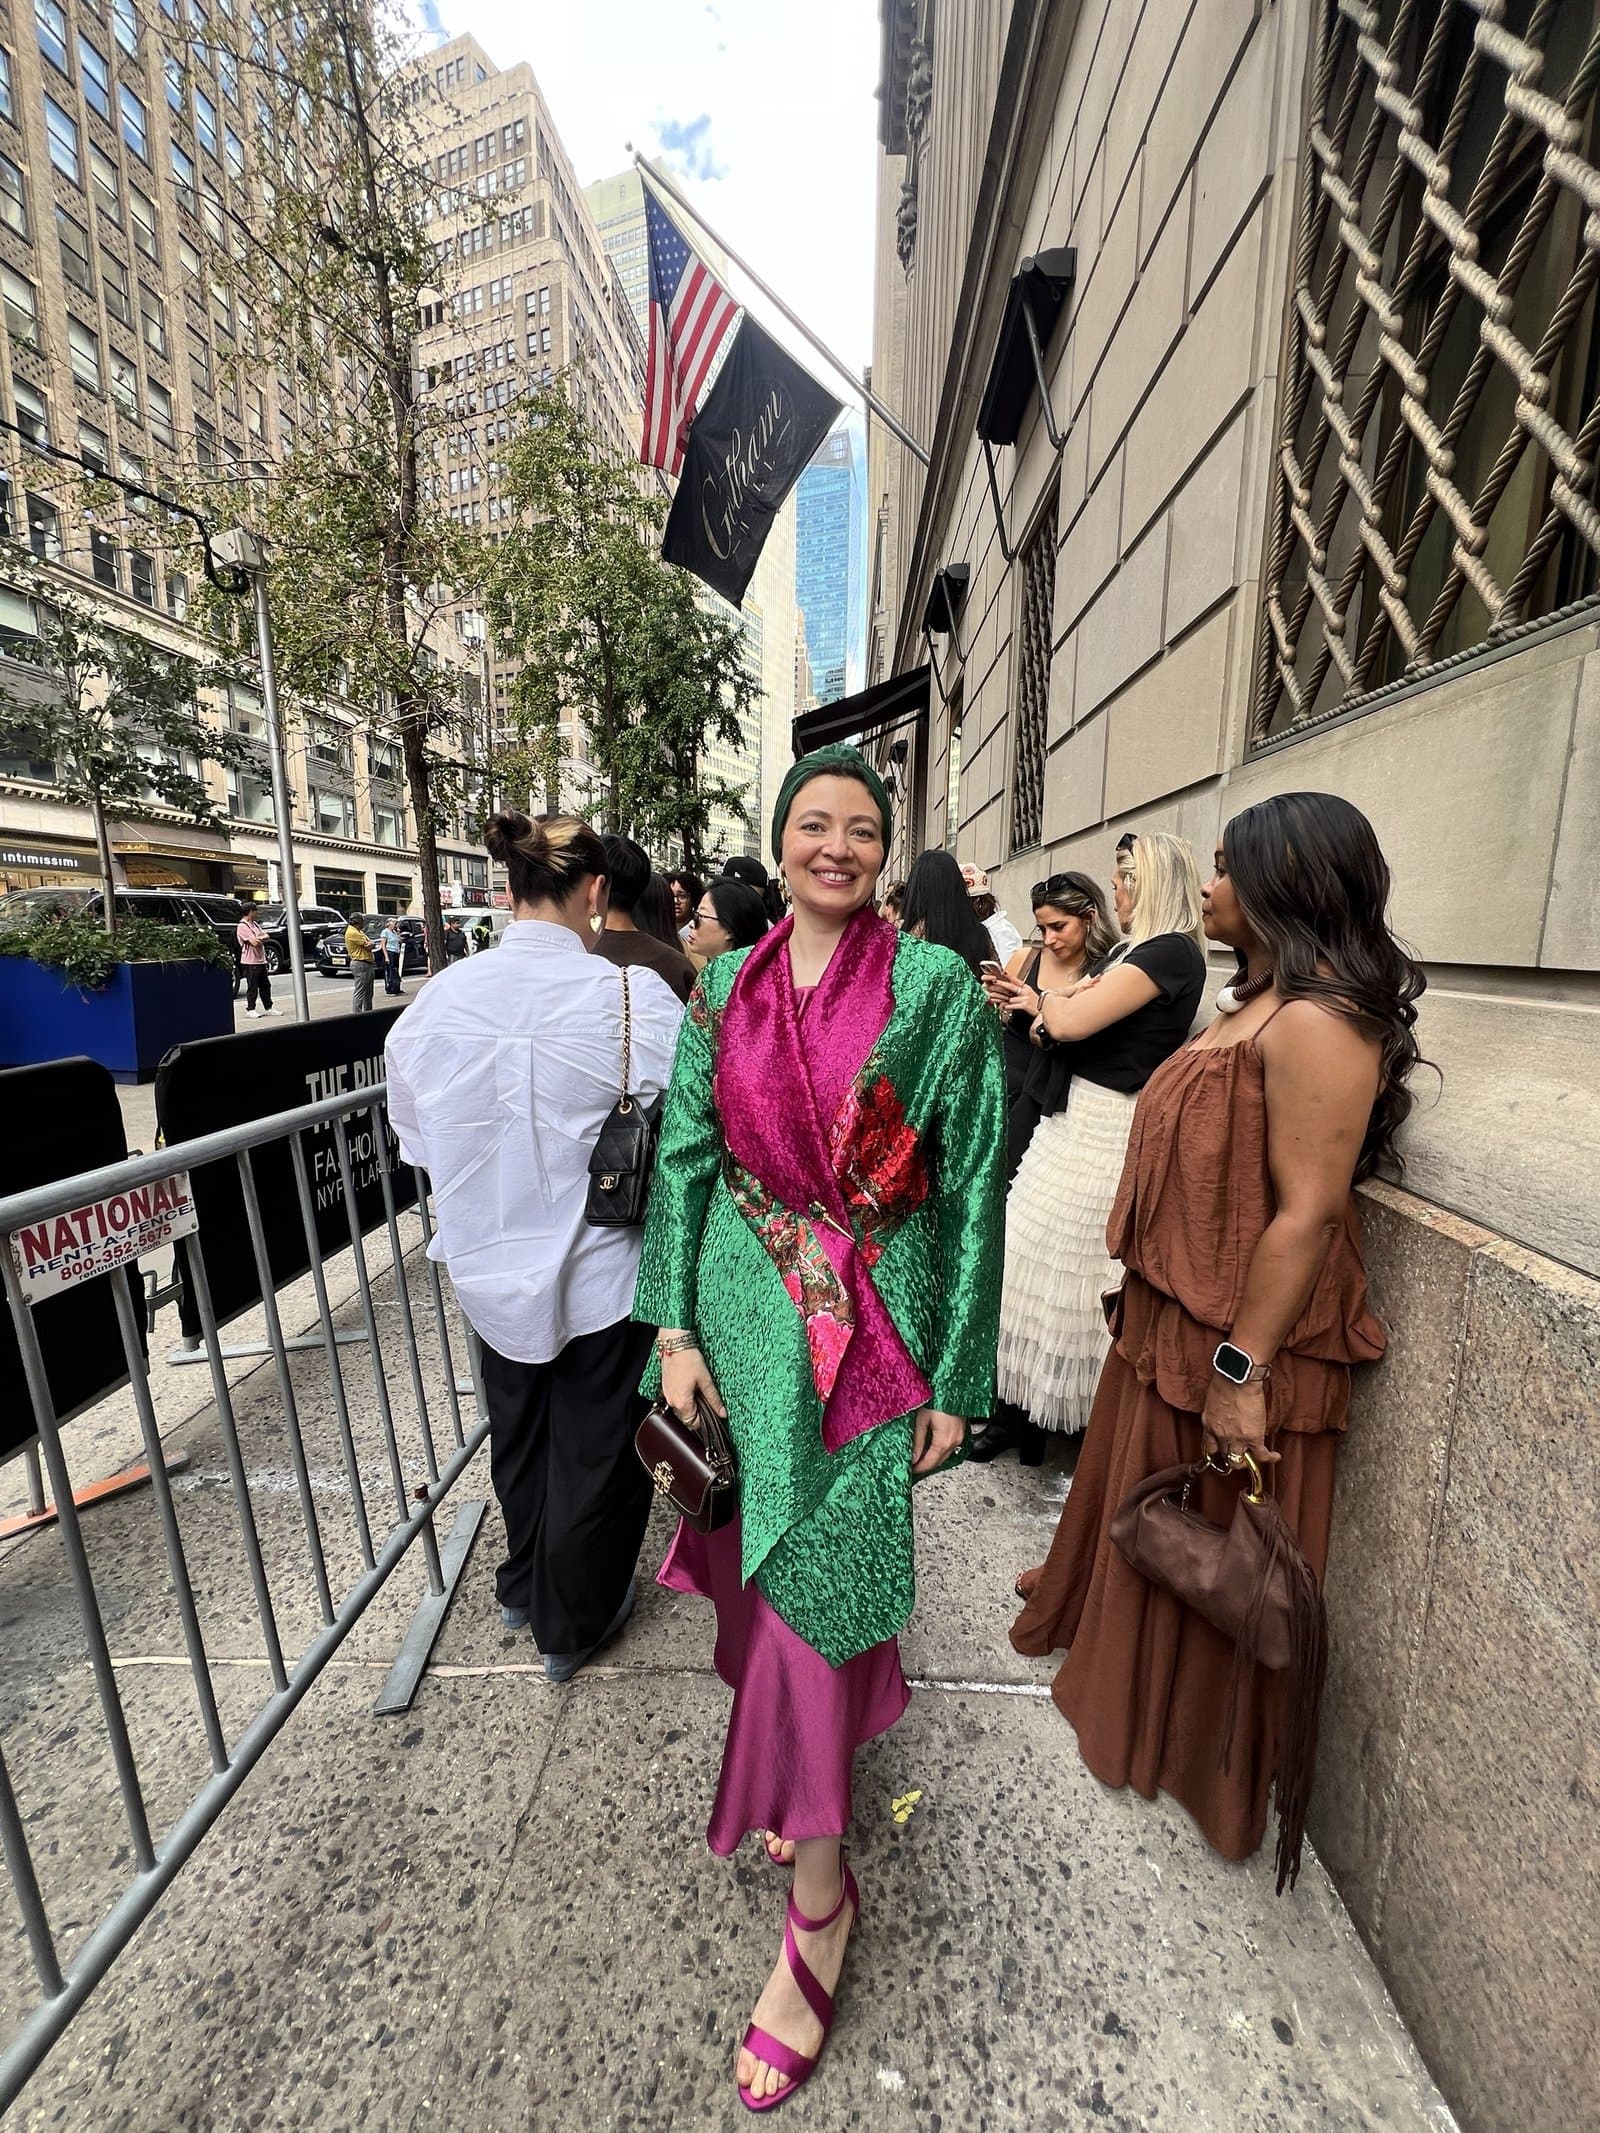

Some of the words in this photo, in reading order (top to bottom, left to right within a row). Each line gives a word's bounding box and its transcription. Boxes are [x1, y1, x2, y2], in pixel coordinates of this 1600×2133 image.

[2, 852, 79, 868] intimissimi
[20, 1177, 188, 1267] NATIONAL
[29, 1205, 193, 1279] RENT-A-FENCE
[60, 1223, 172, 1281] 800-352-5675
[79, 1241, 161, 1281] rentnational.com
